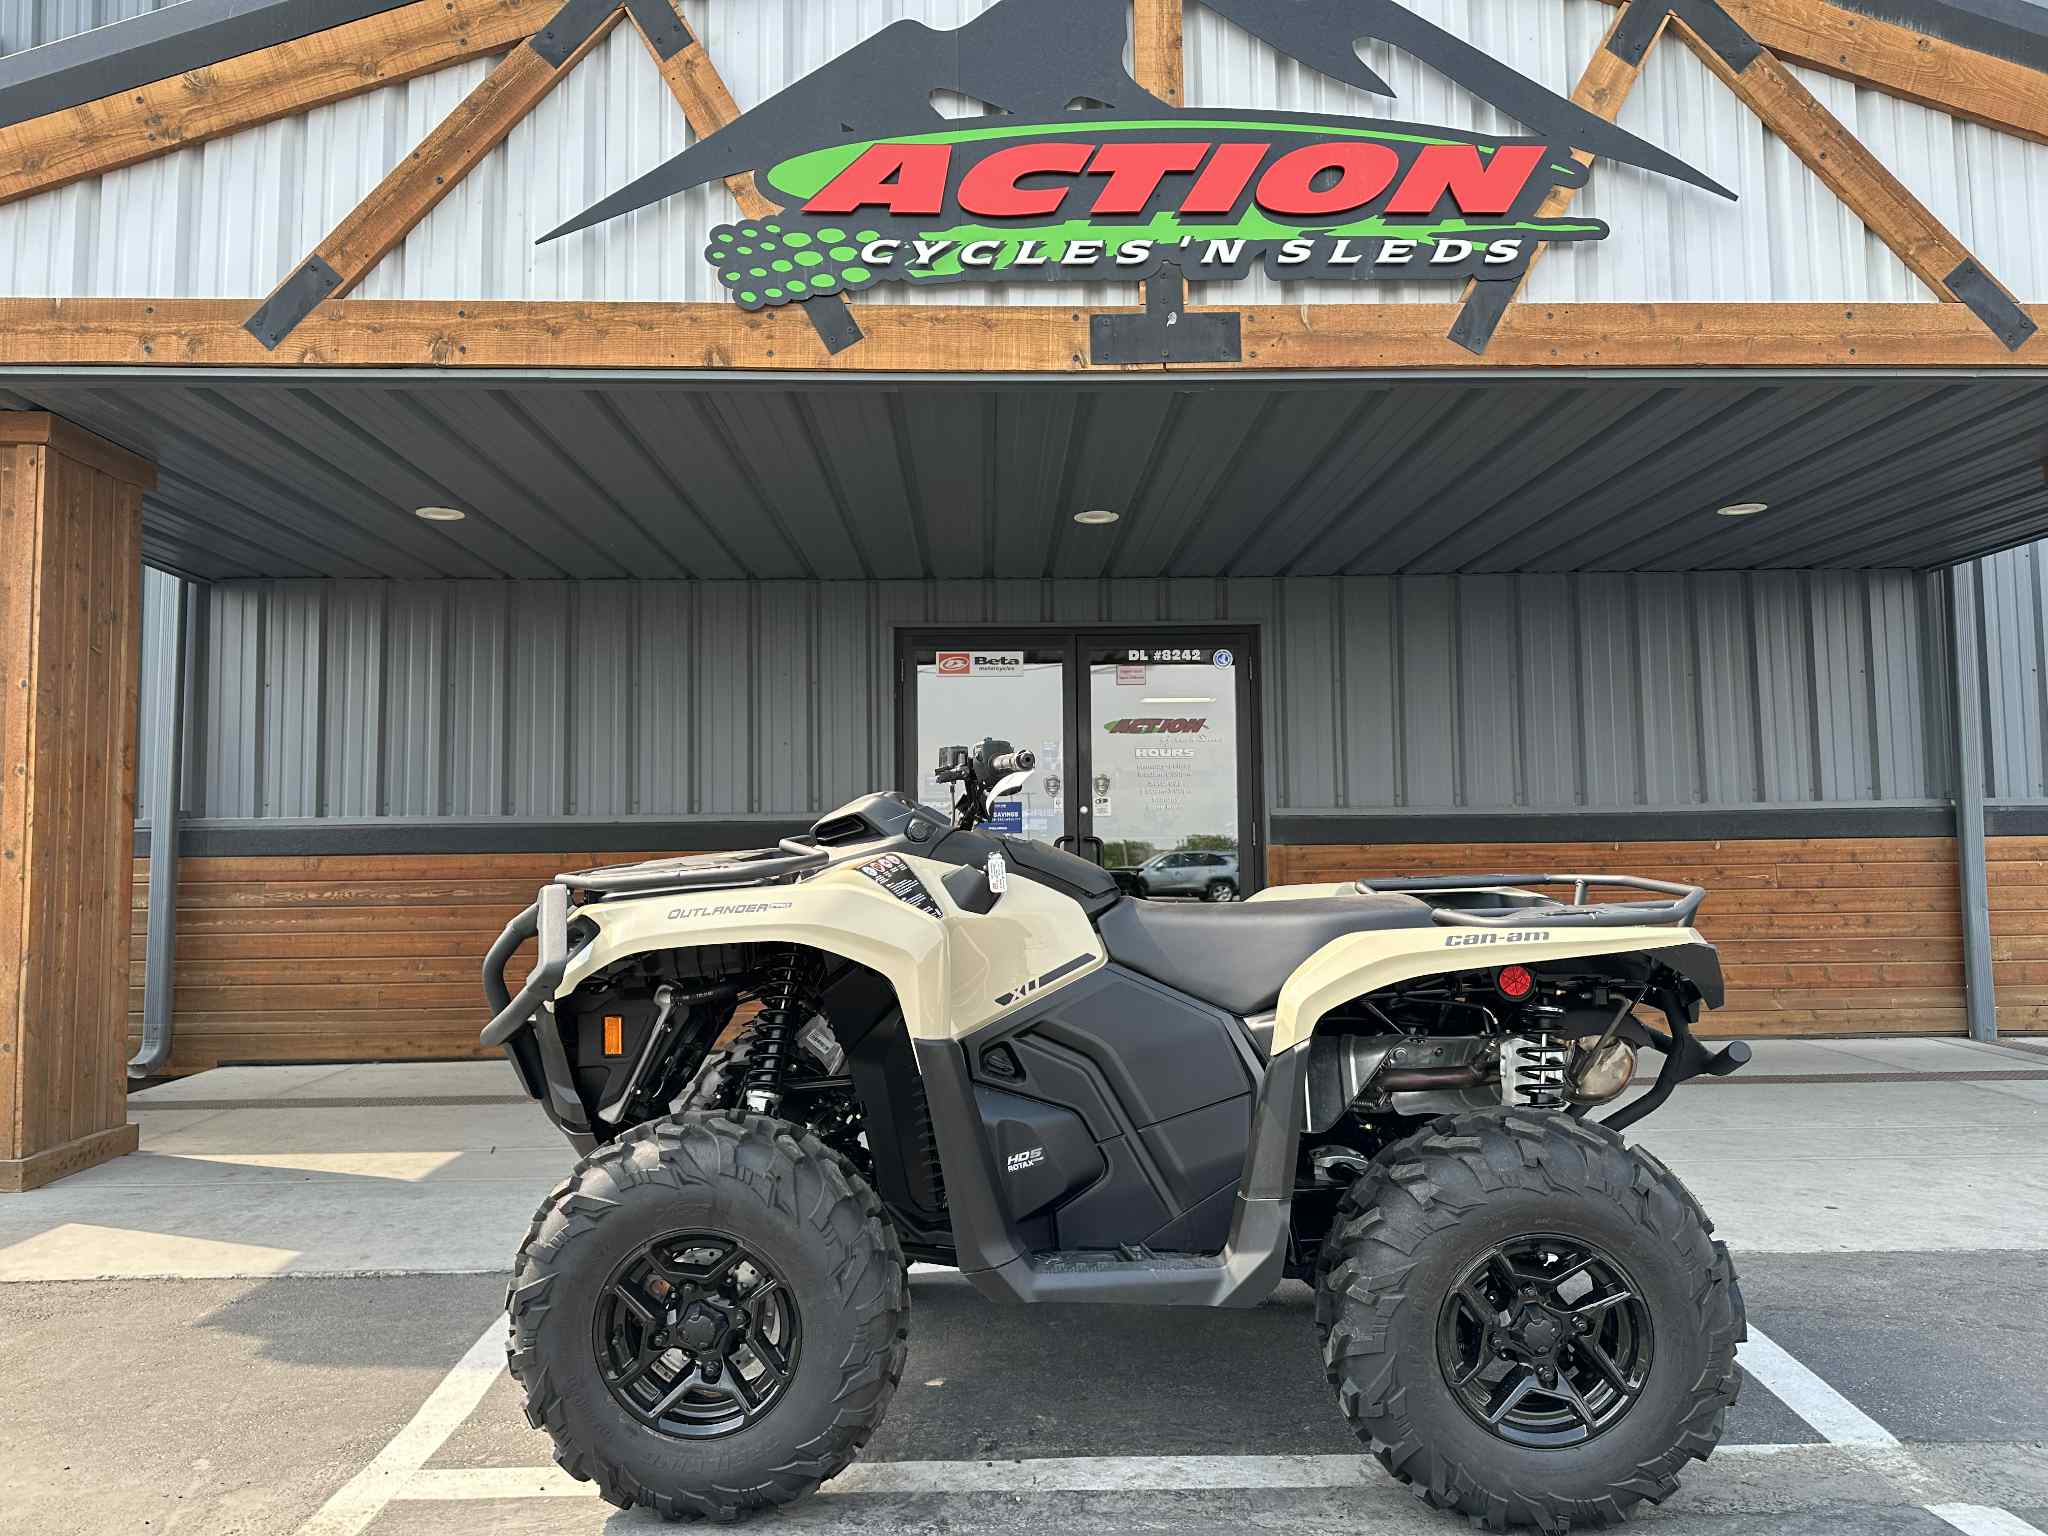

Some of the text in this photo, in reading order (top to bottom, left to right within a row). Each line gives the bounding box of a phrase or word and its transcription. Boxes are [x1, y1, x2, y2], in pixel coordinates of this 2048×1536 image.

[799, 142, 1549, 217] ACTION
[860, 239, 1154, 266] CYCLES
[1277, 239, 1523, 265] SLEDS
[974, 656, 1020, 665] Beta
[1128, 649, 1201, 661] DL #8242
[1109, 718, 1207, 734] ACTION
[1135, 747, 1194, 758] HOURS
[667, 903, 768, 920] OUTLANDER
[1445, 931, 1550, 947] can-am
[1007, 1160, 1035, 1173] ROTAX
